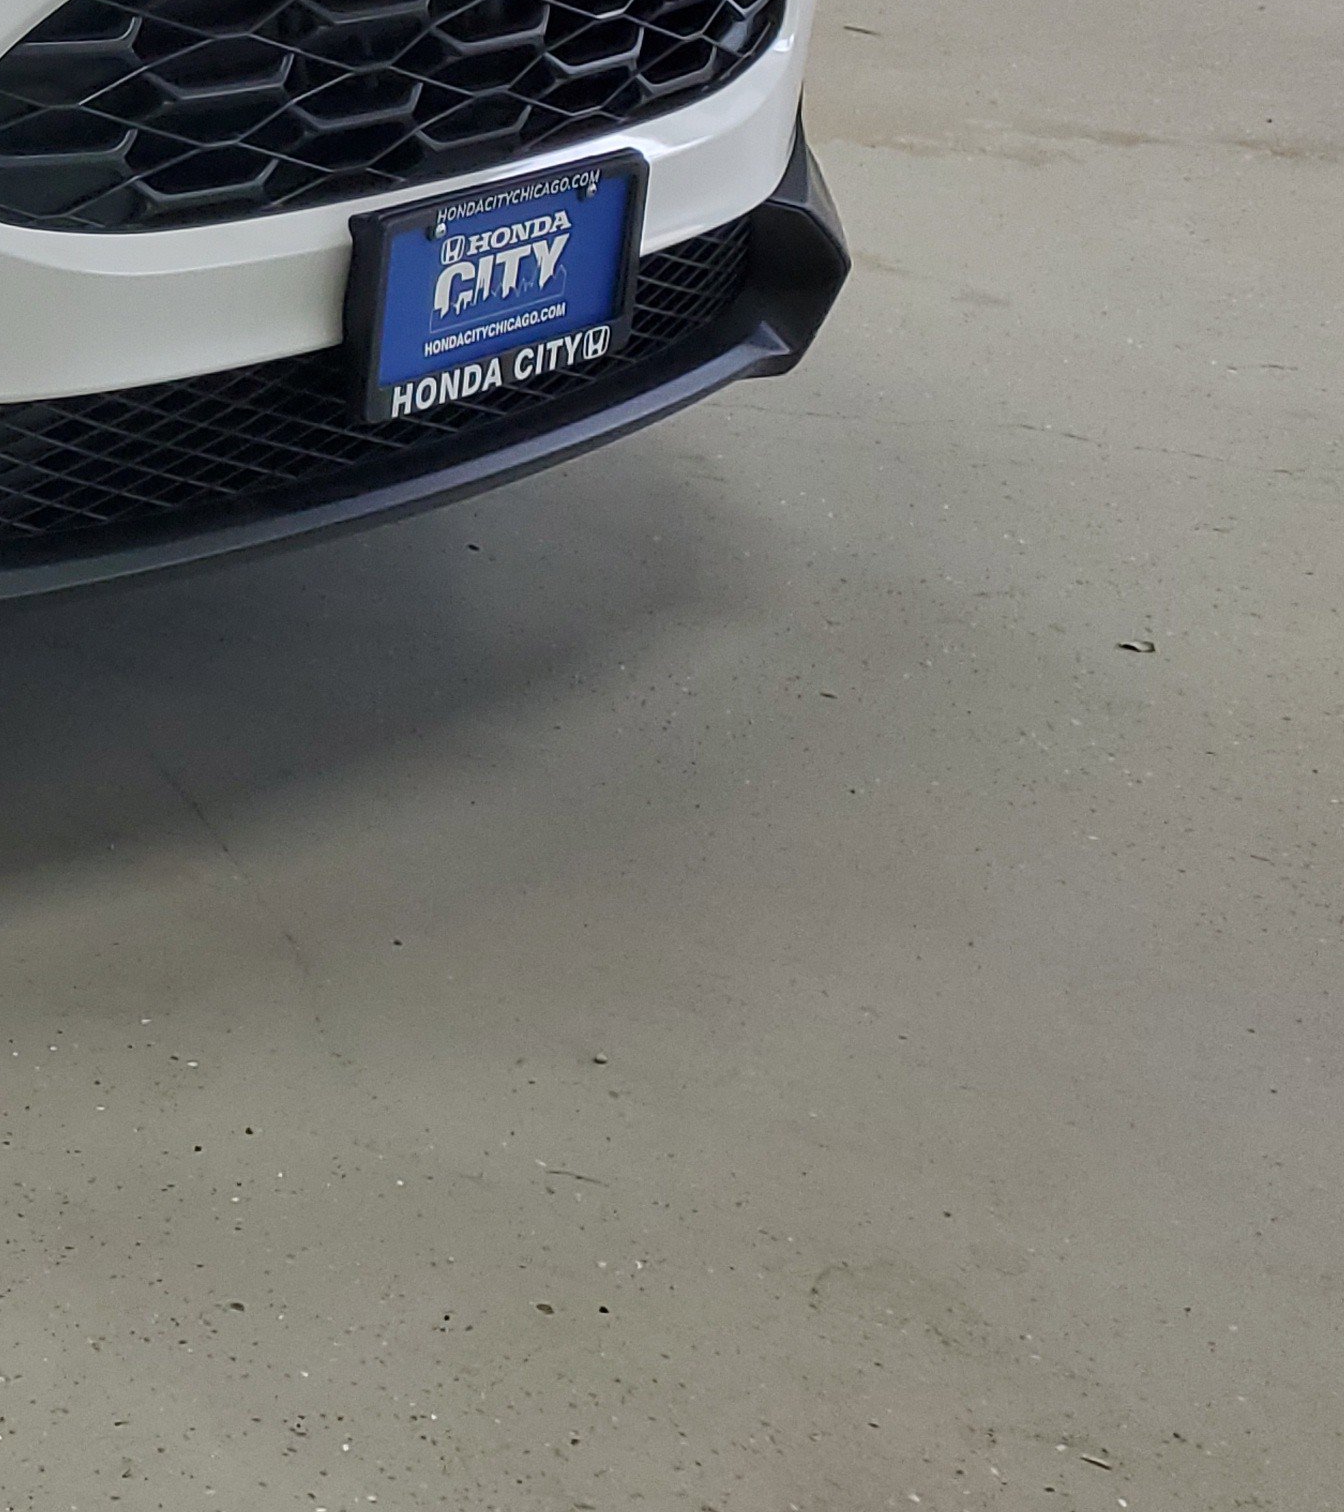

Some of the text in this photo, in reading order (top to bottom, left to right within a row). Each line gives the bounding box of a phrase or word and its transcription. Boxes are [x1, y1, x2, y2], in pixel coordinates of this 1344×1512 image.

[437, 169, 601, 223] HONDACITYCHICAGO.COM
[466, 210, 572, 256] HONDA
[434, 232, 571, 320] CITY
[424, 302, 566, 357] HONDACITYCHICAGO.COM
[391, 333, 584, 418] HONDA CITY
